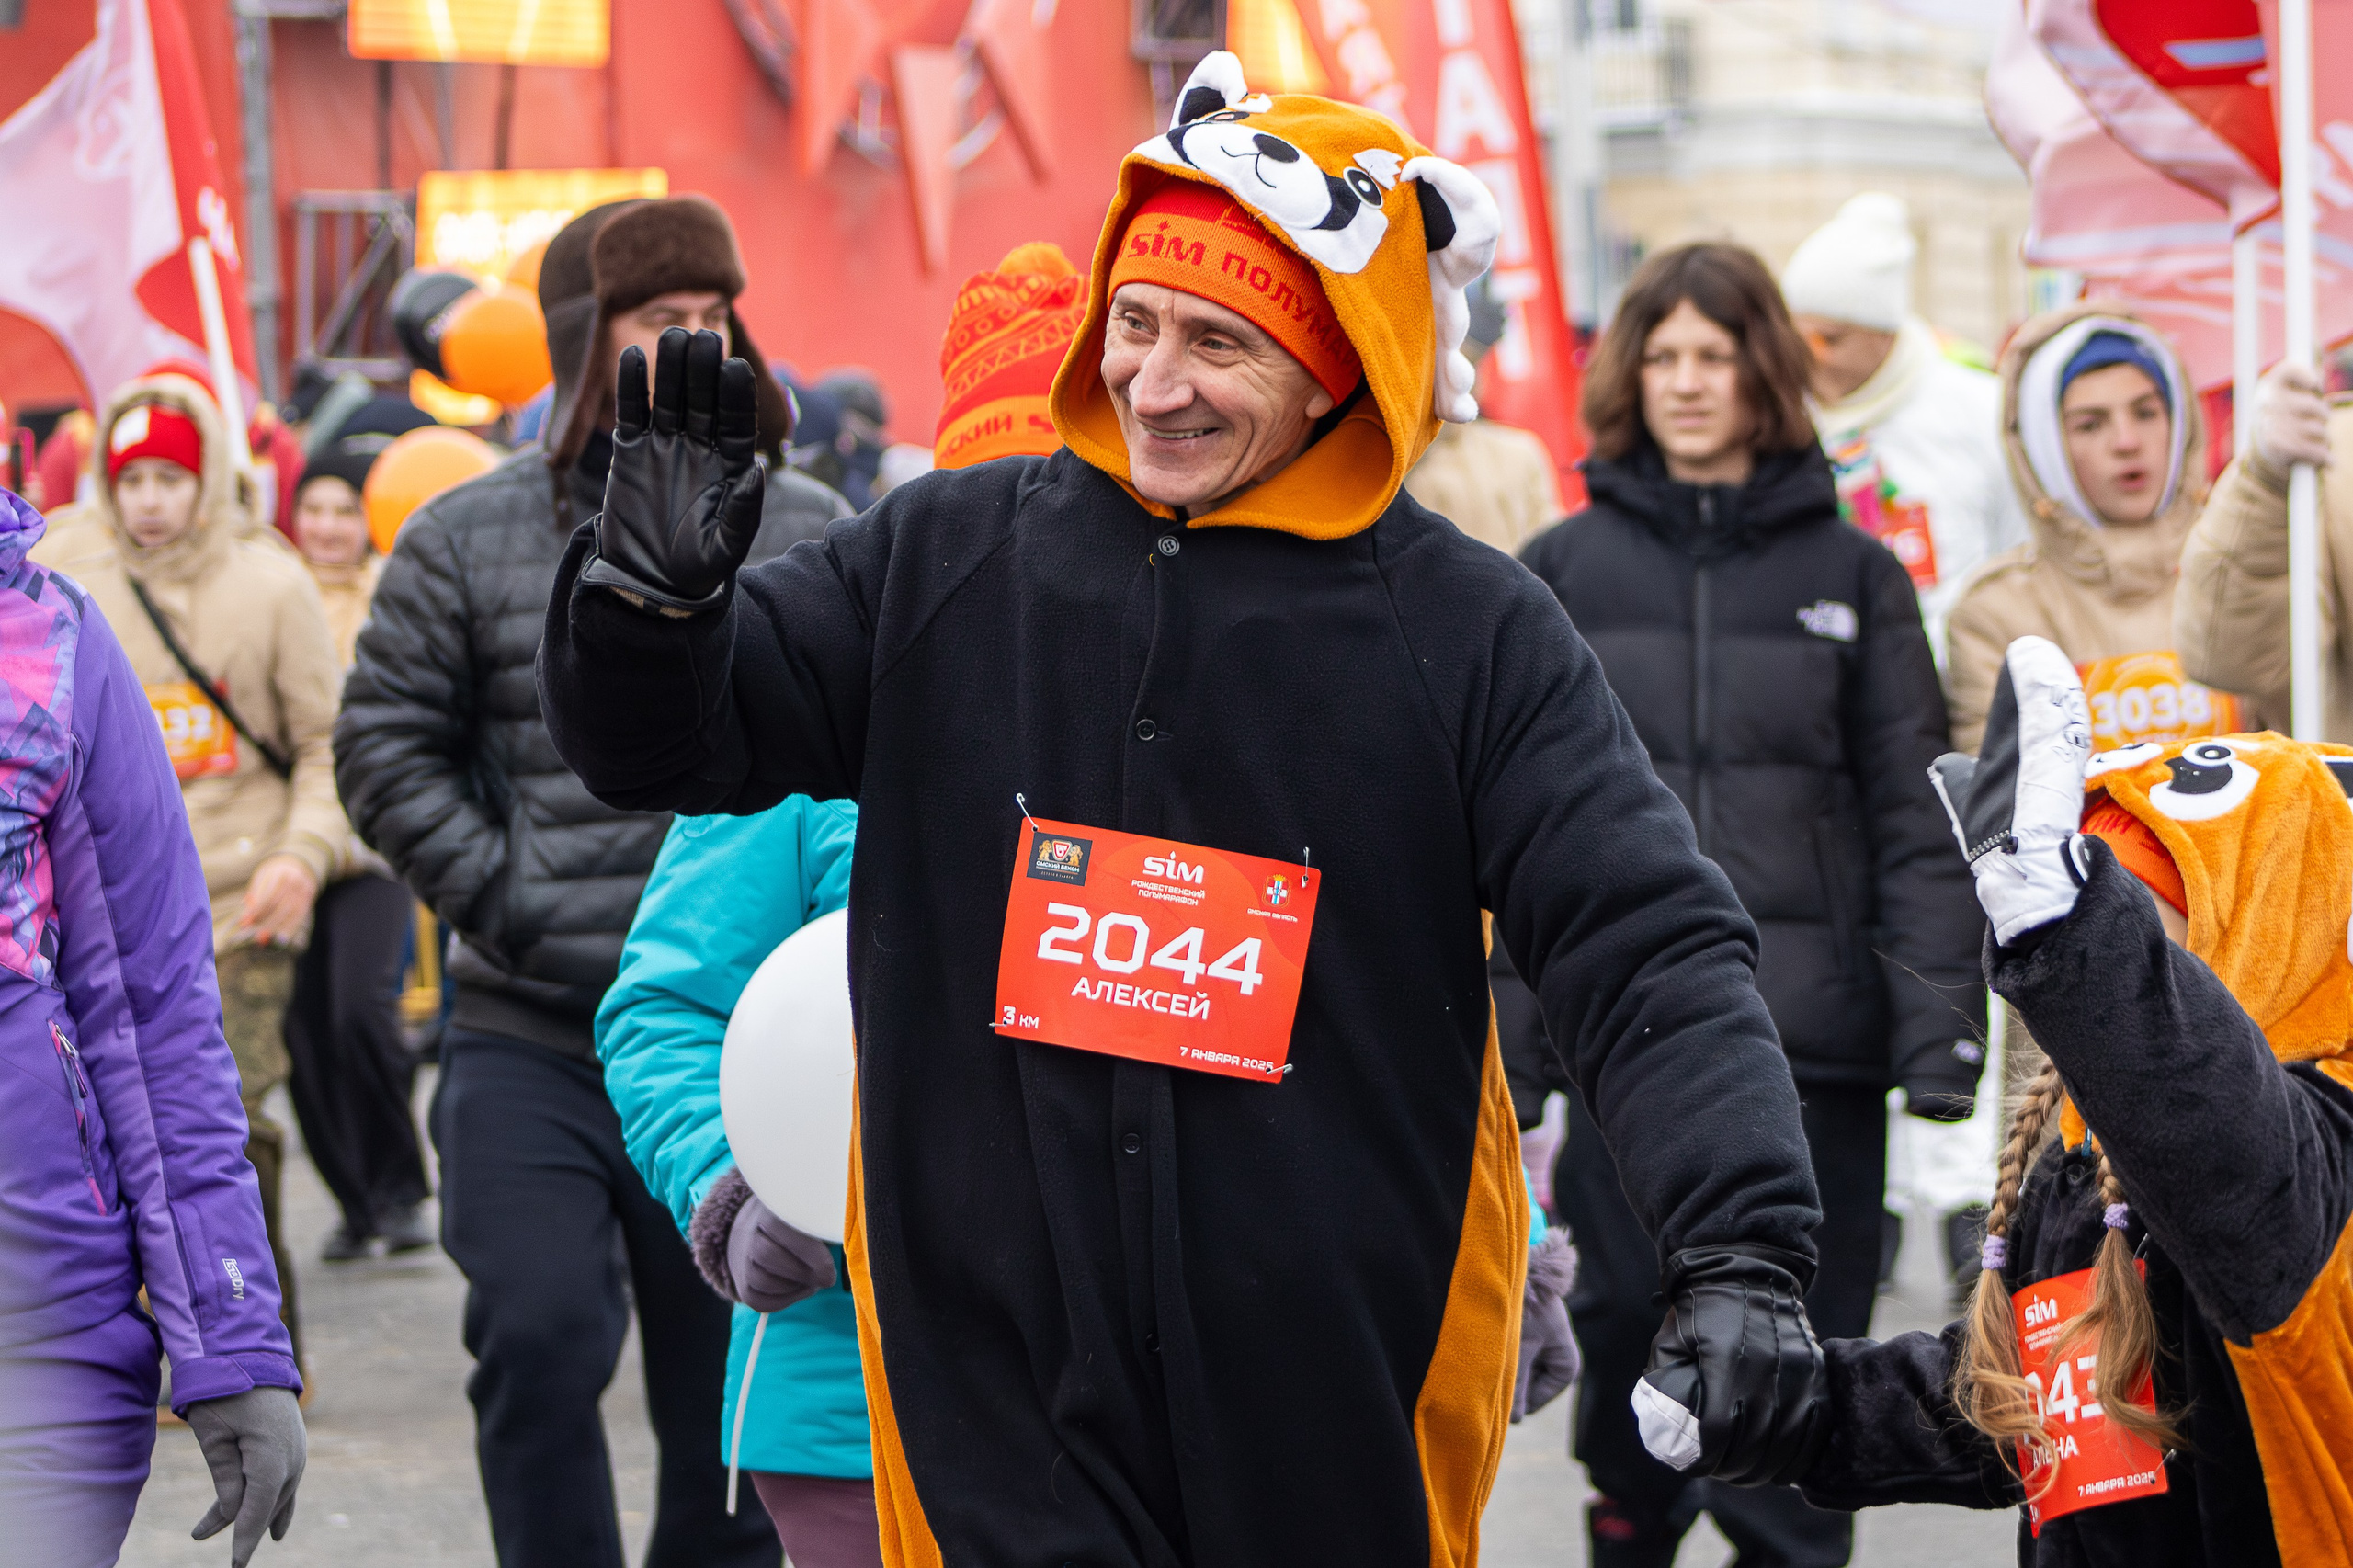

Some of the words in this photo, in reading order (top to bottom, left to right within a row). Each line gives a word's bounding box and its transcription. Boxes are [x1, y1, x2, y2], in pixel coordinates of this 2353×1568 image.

[2089, 681, 2211, 735] 3038
[1131, 880, 1205, 899] РОЖДЕСТВЕНСКИЙ
[1138, 889, 1199, 906] ПОЛУМАРАФОН
[1037, 902, 1264, 996] 2044
[1071, 976, 1211, 1021] АЛЕКСЕЙ
[1003, 1005, 1016, 1026] 3
[1179, 1046, 1188, 1057] 7
[1190, 1048, 1241, 1066] ЯНВАРЯ
[1242, 1057, 1274, 1073] 2025
[2077, 1485, 2086, 1497] 7
[2086, 1476, 2125, 1496] ЯНВАРЯ
[2127, 1471, 2156, 1486] 2025
